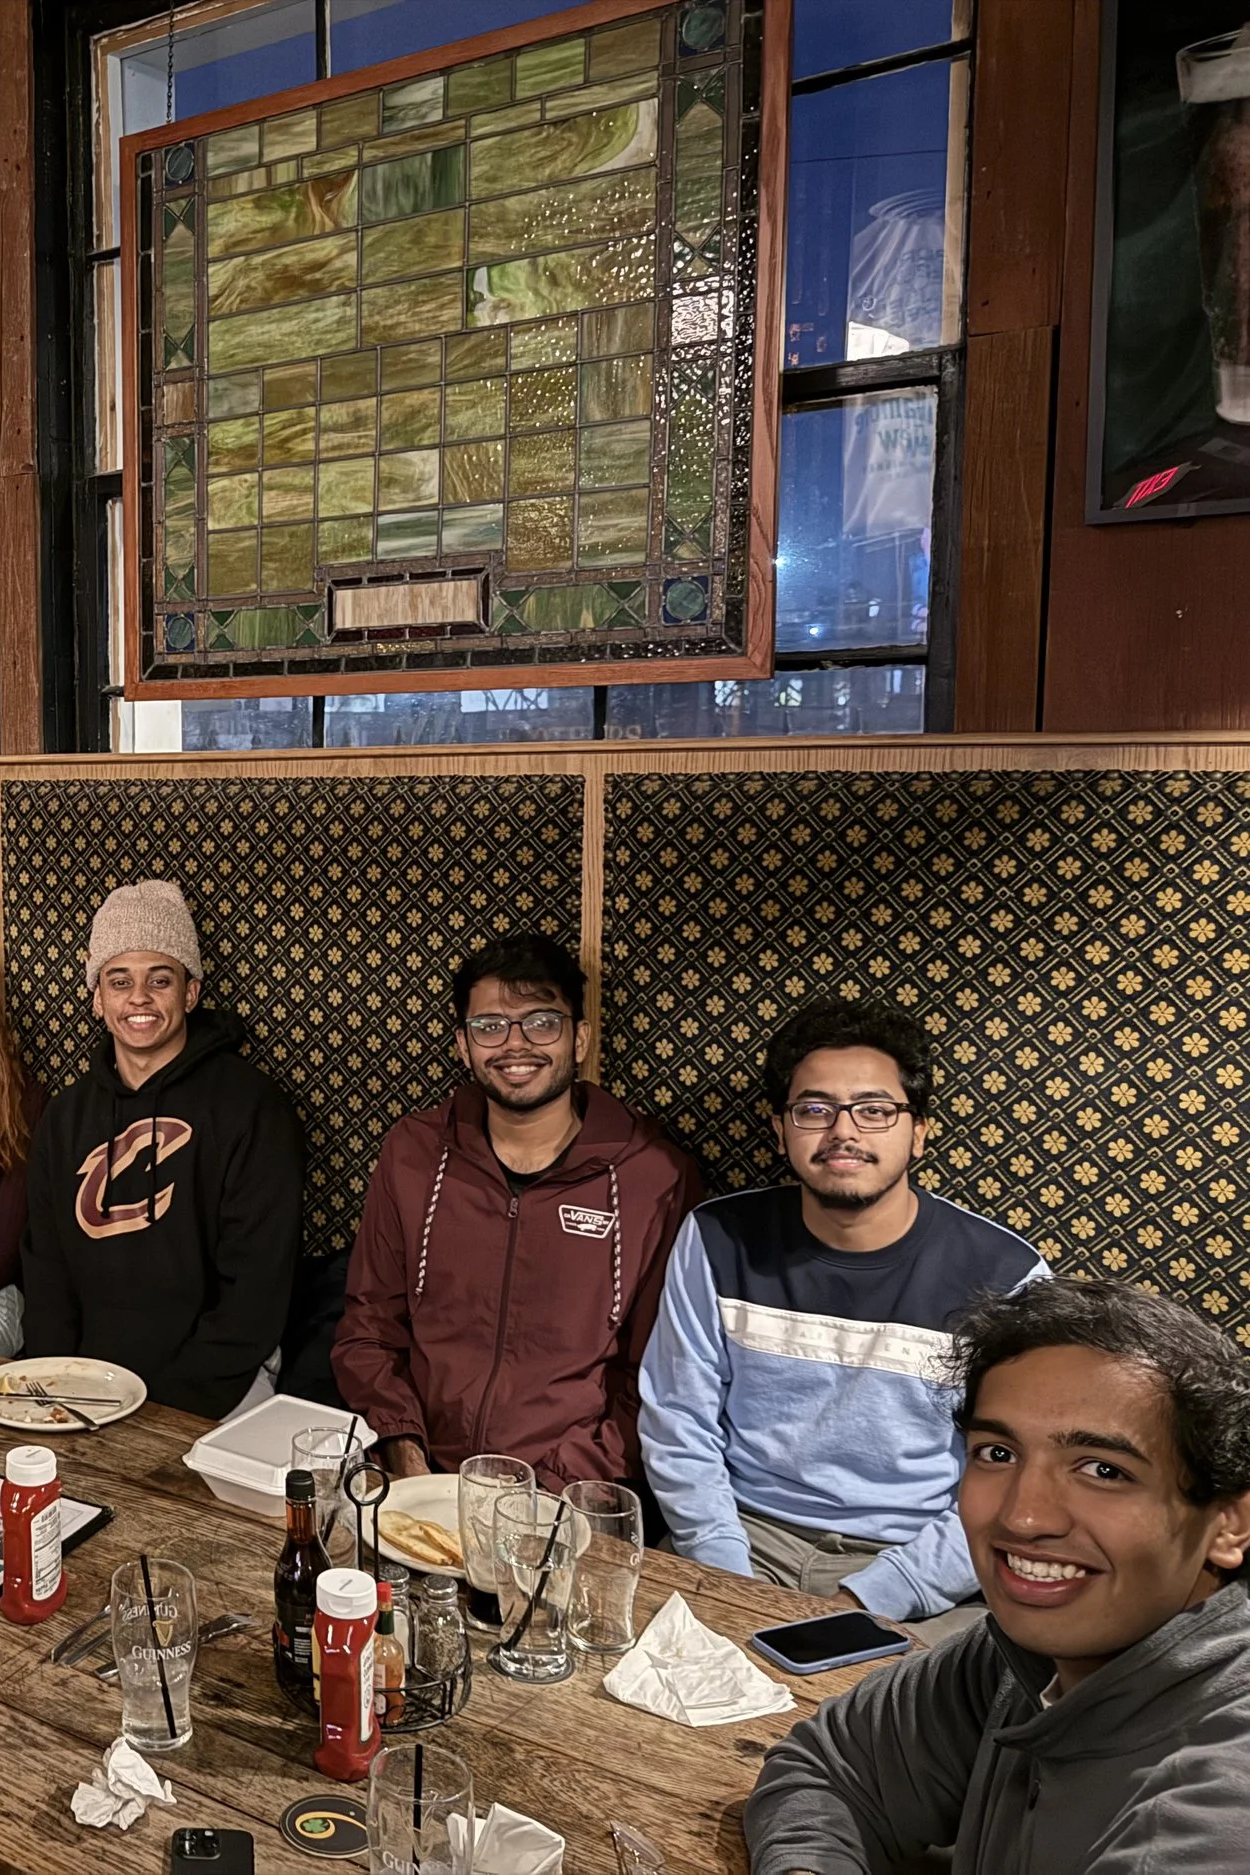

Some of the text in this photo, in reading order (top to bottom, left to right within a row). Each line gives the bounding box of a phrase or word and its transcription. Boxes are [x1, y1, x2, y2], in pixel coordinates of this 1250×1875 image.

[75, 1117, 192, 1239] C
[570, 1210, 605, 1226] VANS
[132, 1640, 192, 1660] GUINNESS
